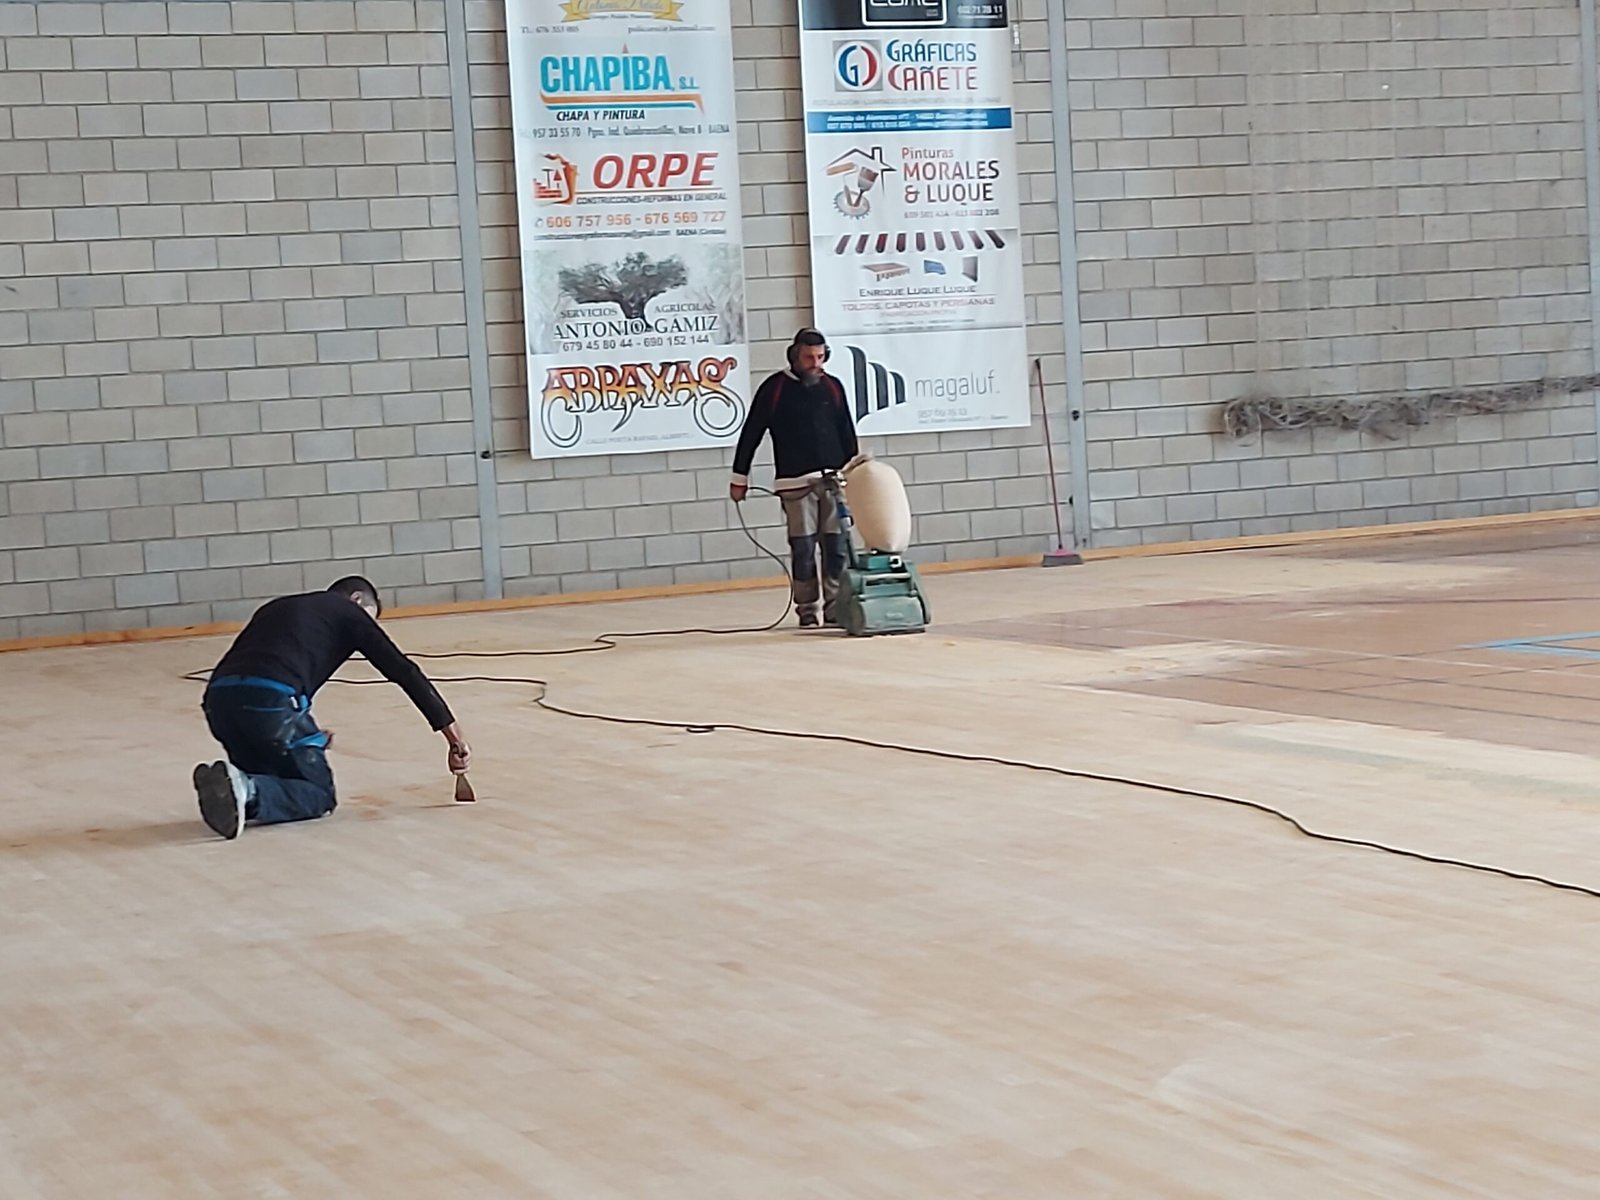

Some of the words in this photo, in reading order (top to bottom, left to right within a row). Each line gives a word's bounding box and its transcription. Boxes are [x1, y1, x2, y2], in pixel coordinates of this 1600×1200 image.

[886, 38, 977, 62] GRÁFICAS
[887, 64, 979, 91] CAÑETE
[556, 110, 590, 122] CHAPA
[593, 110, 600, 120] Y
[602, 109, 645, 120] PINTURA
[560, 127, 570, 137] 55
[571, 127, 581, 137] 70
[902, 147, 954, 160] Pinturas
[593, 152, 719, 190] ORPE
[904, 160, 1000, 182] MORALES
[905, 186, 920, 204] &
[926, 183, 994, 206] LUQUE
[546, 216, 572, 228] 606
[576, 215, 601, 227] 757
[607, 214, 632, 226] 956
[644, 213, 669, 225] 676
[703, 210, 726, 222] 727
[859, 288, 904, 298] ENRIQUE
[907, 286, 942, 296] LUQUE
[943, 284, 977, 294] LUQUE
[885, 300, 930, 310] CAPOTAS
[940, 297, 995, 307] PERSIANAS
[560, 307, 618, 319] SERVICIOS
[553, 318, 644, 339] ANTONIO
[562, 341, 583, 352] 679
[586, 340, 600, 350] 45
[602, 339, 616, 349] 80
[619, 338, 633, 348] 44
[668, 335, 687, 346] 152
[691, 334, 710, 345] 144
